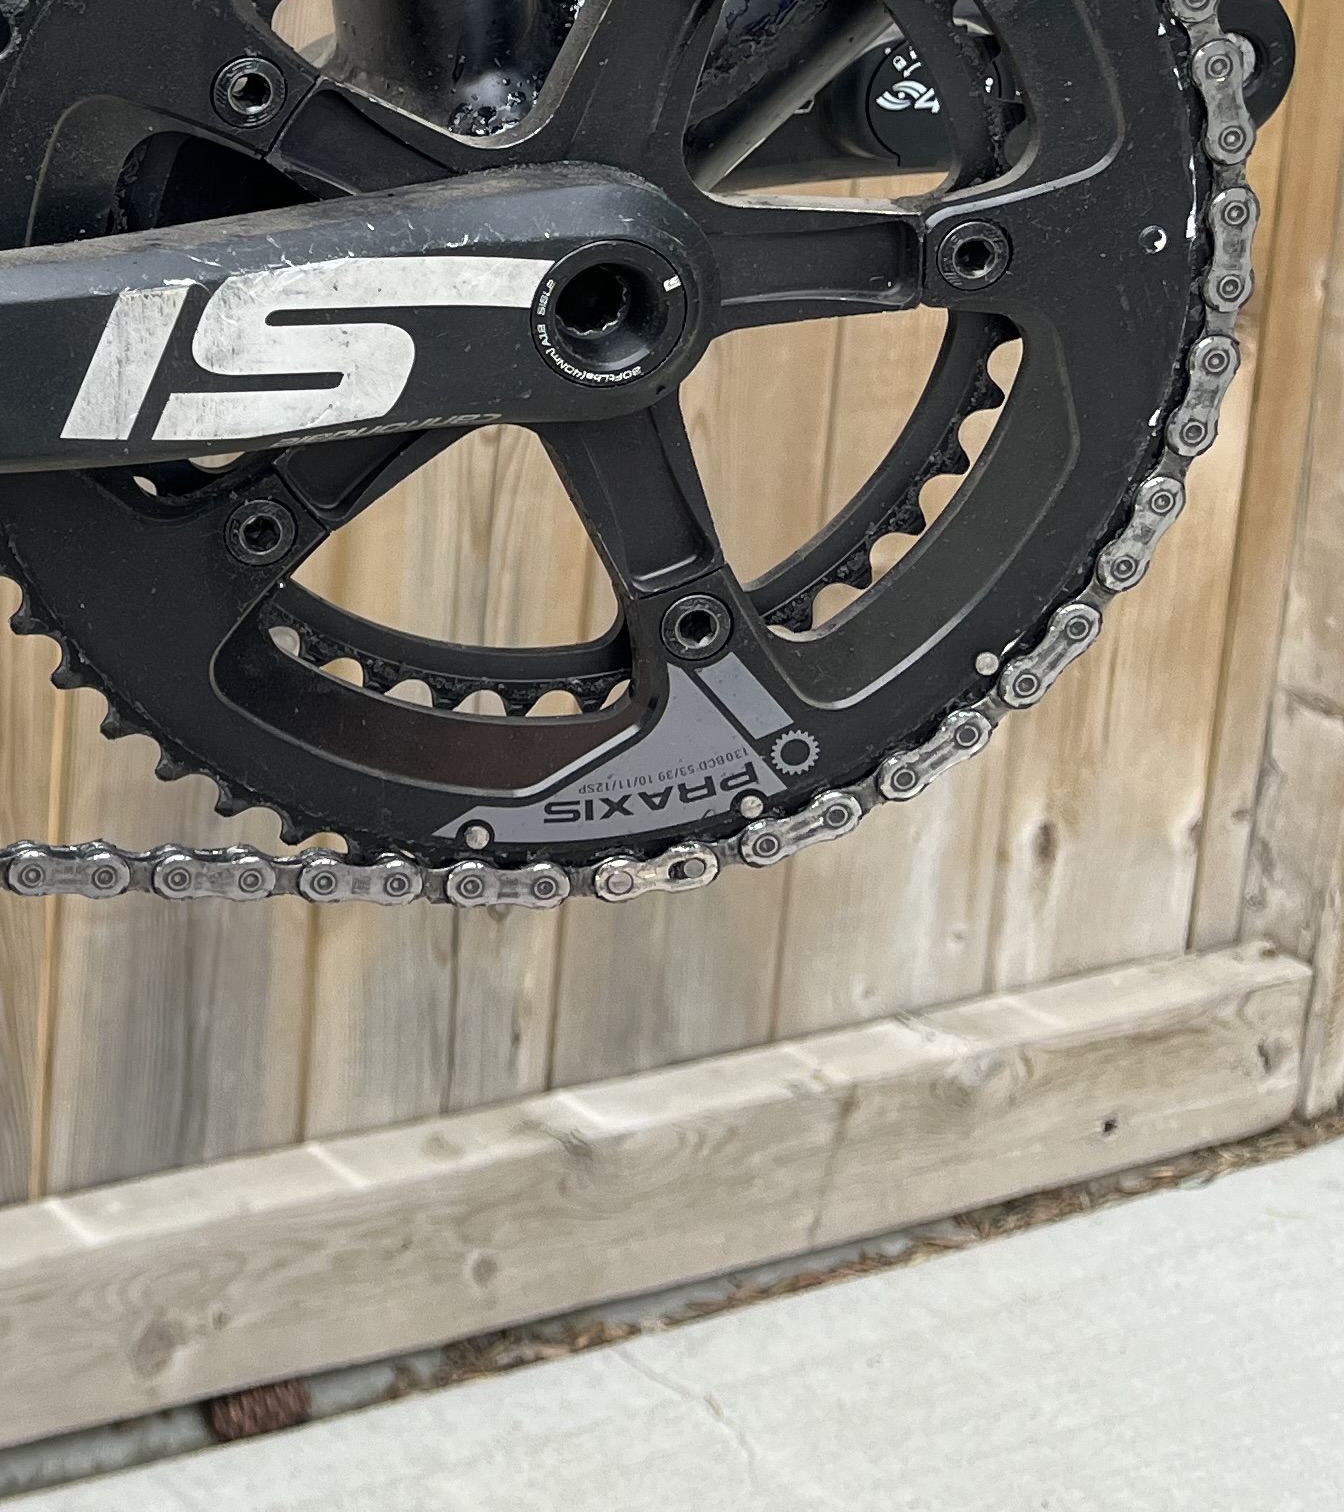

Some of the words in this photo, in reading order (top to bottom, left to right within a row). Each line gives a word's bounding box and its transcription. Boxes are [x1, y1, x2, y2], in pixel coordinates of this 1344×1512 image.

[699, 747, 749, 771] 130BCD
[658, 763, 695, 782] 53/39
[543, 761, 760, 824] PRAXIS
[578, 775, 652, 795] 10/11/12SP
